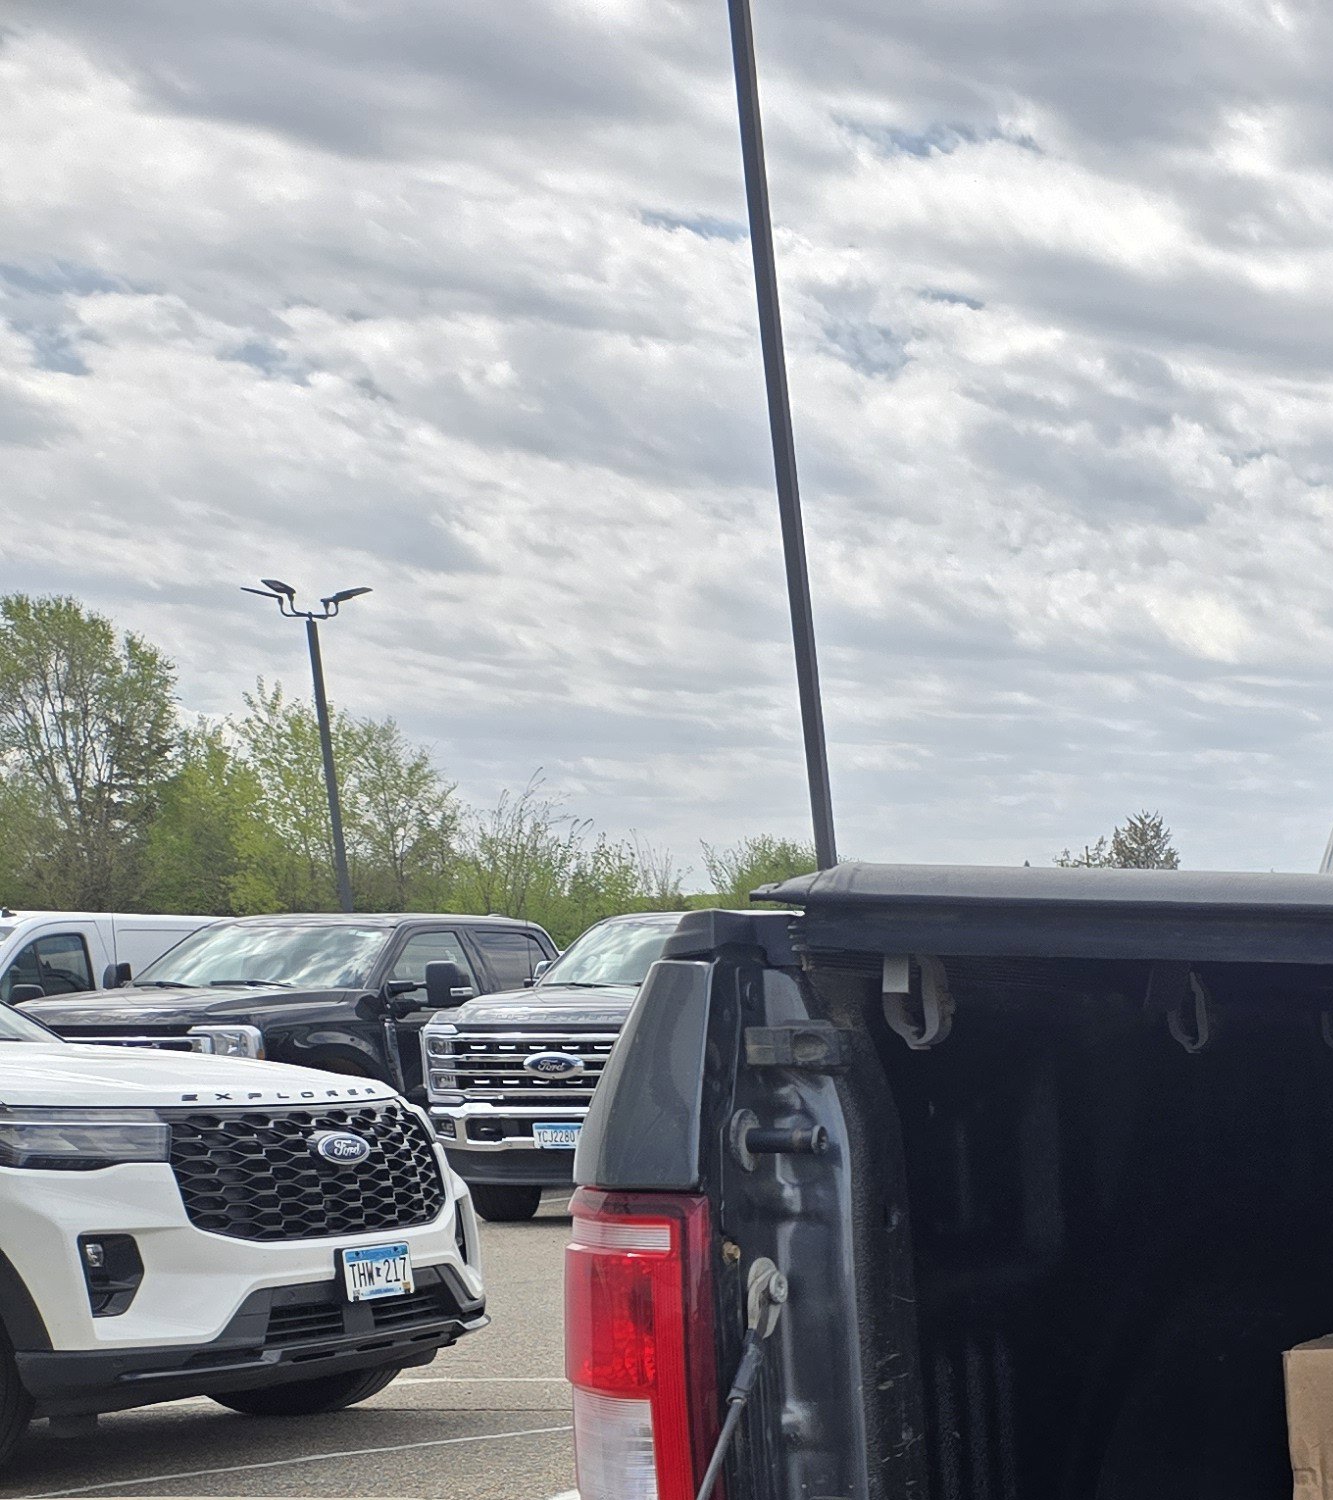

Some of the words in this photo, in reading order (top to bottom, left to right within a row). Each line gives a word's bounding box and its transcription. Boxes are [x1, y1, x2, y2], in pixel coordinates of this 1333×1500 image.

[538, 1059, 565, 1071] Ford
[181, 1087, 376, 1102] EXPLORER
[537, 1130, 575, 1143] YCJ2280
[333, 1139, 361, 1156] Ford
[349, 1261, 375, 1288] THW
[383, 1257, 406, 1283] 217
